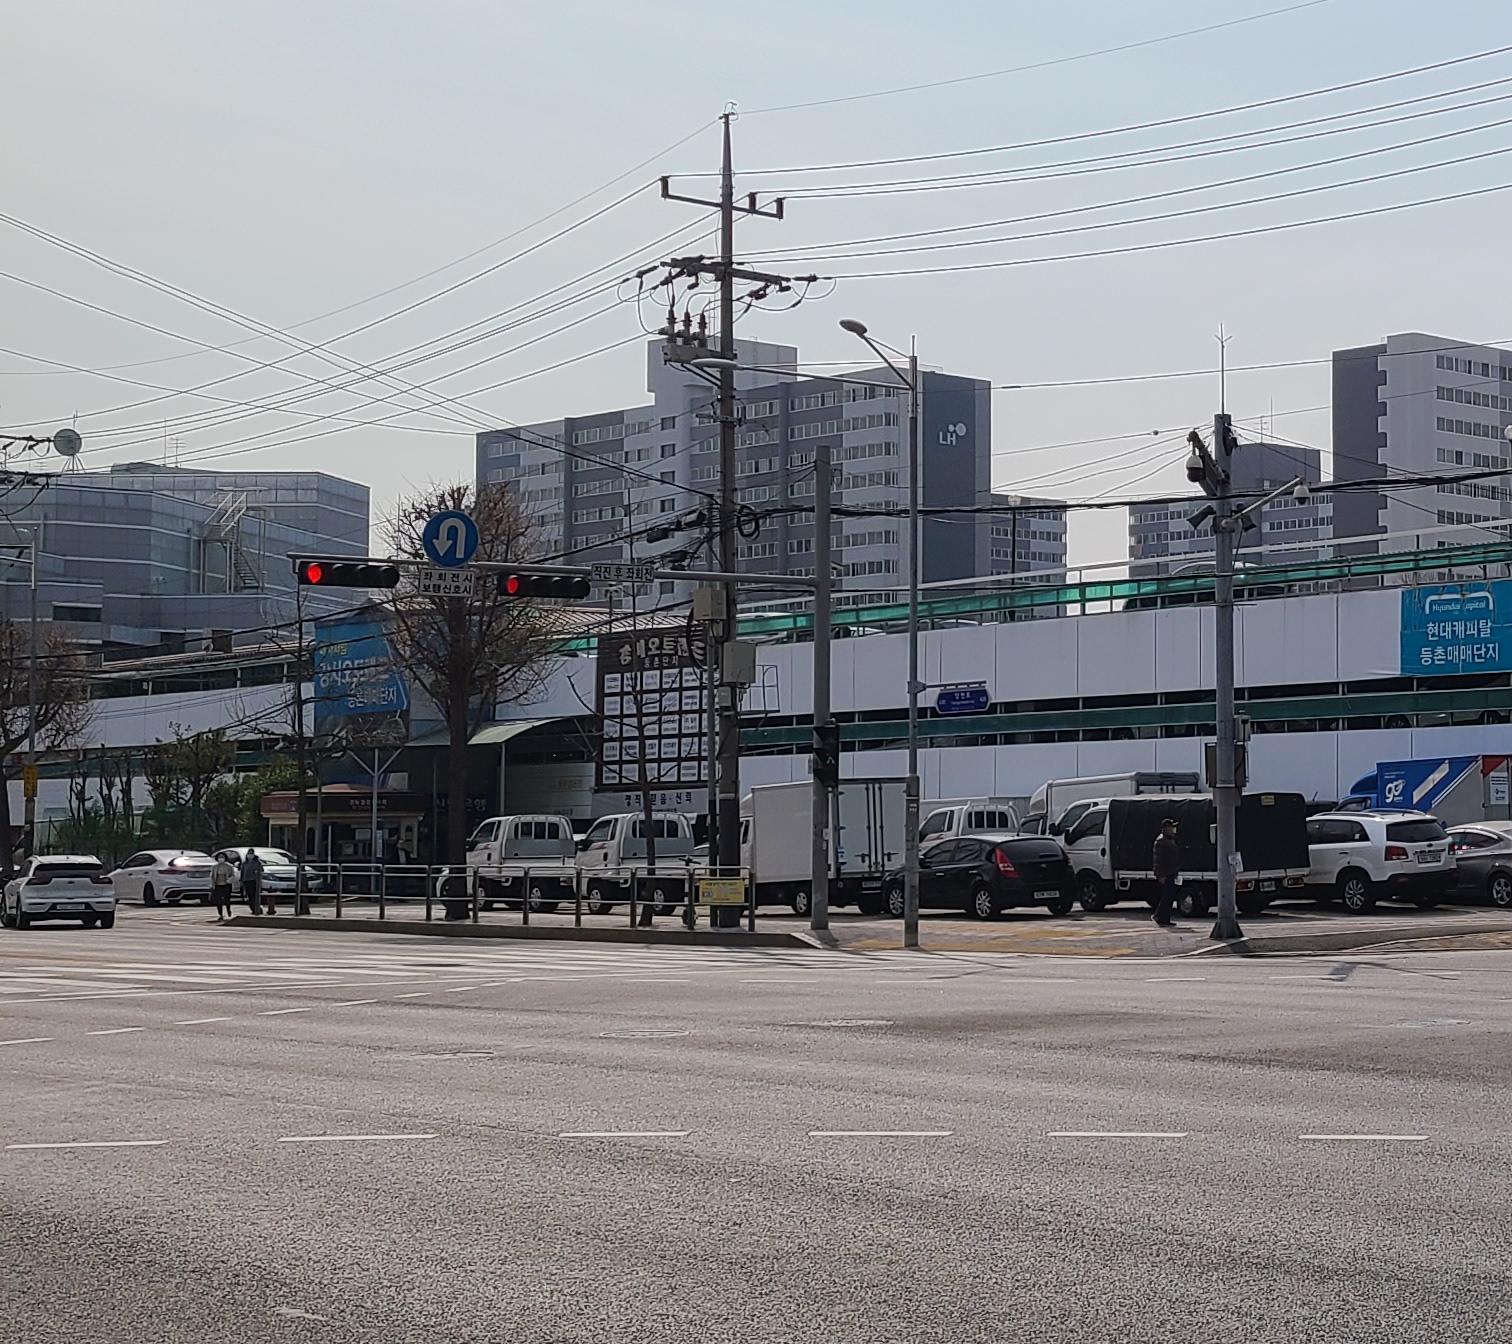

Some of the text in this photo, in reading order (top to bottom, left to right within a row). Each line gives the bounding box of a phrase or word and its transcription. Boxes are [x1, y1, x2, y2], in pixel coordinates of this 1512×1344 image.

[939, 431, 956, 446] LH
[423, 571, 473, 583] 좌회전시
[422, 583, 473, 595] 보행신호시
[1427, 618, 1493, 641] 현대캐피탈
[1420, 642, 1499, 666] 등촌매매단지
